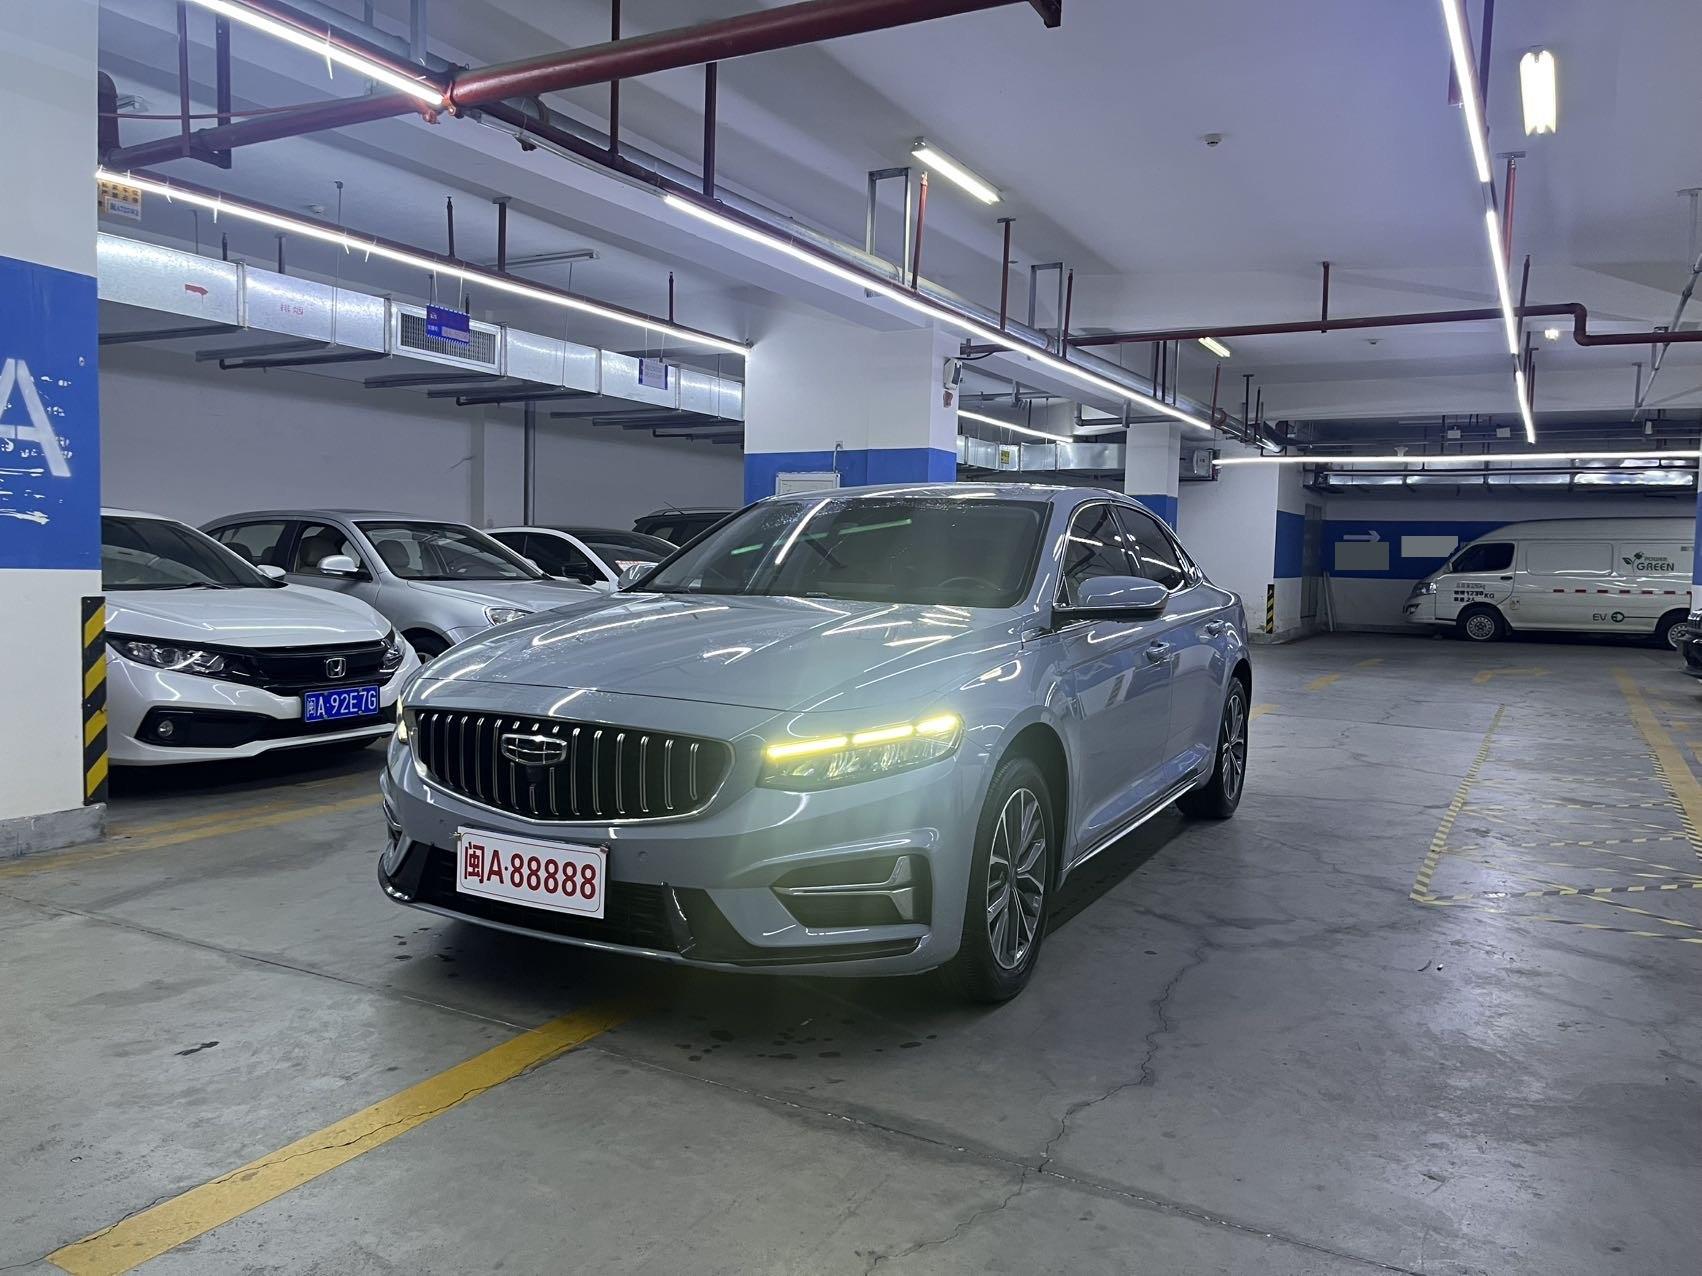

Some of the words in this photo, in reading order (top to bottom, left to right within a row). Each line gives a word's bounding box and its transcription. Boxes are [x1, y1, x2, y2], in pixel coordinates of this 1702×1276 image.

[1636, 562, 1675, 571] GREEN
[1592, 613, 1608, 621] EV
[307, 690, 377, 717] 闽A·92E7G
[464, 841, 597, 900] 闽A·88888
